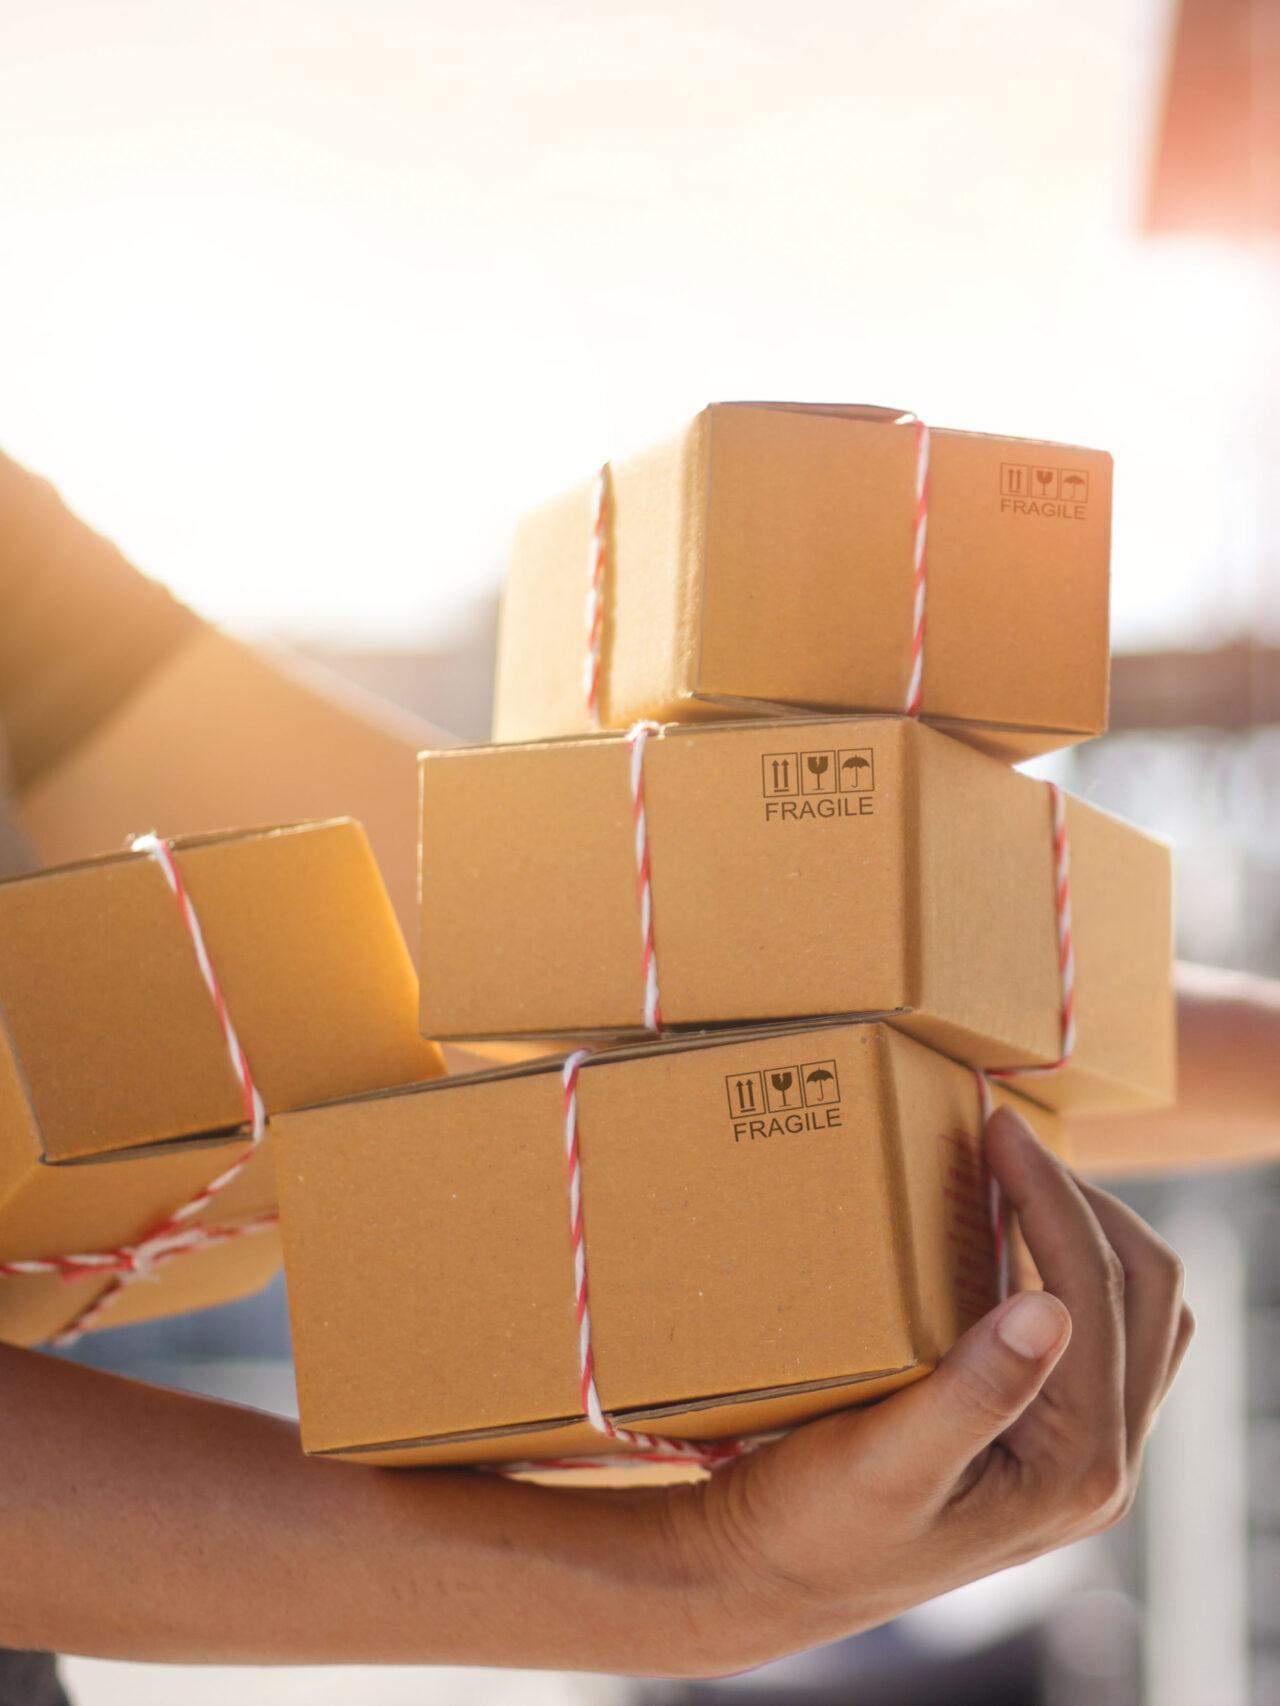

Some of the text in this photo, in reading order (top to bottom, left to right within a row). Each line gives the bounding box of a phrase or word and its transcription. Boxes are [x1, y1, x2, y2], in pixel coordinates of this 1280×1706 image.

[1000, 499, 1086, 520] FRAGILE
[765, 796, 874, 821] FRAGILE
[733, 1108, 842, 1142] FRAGILE
